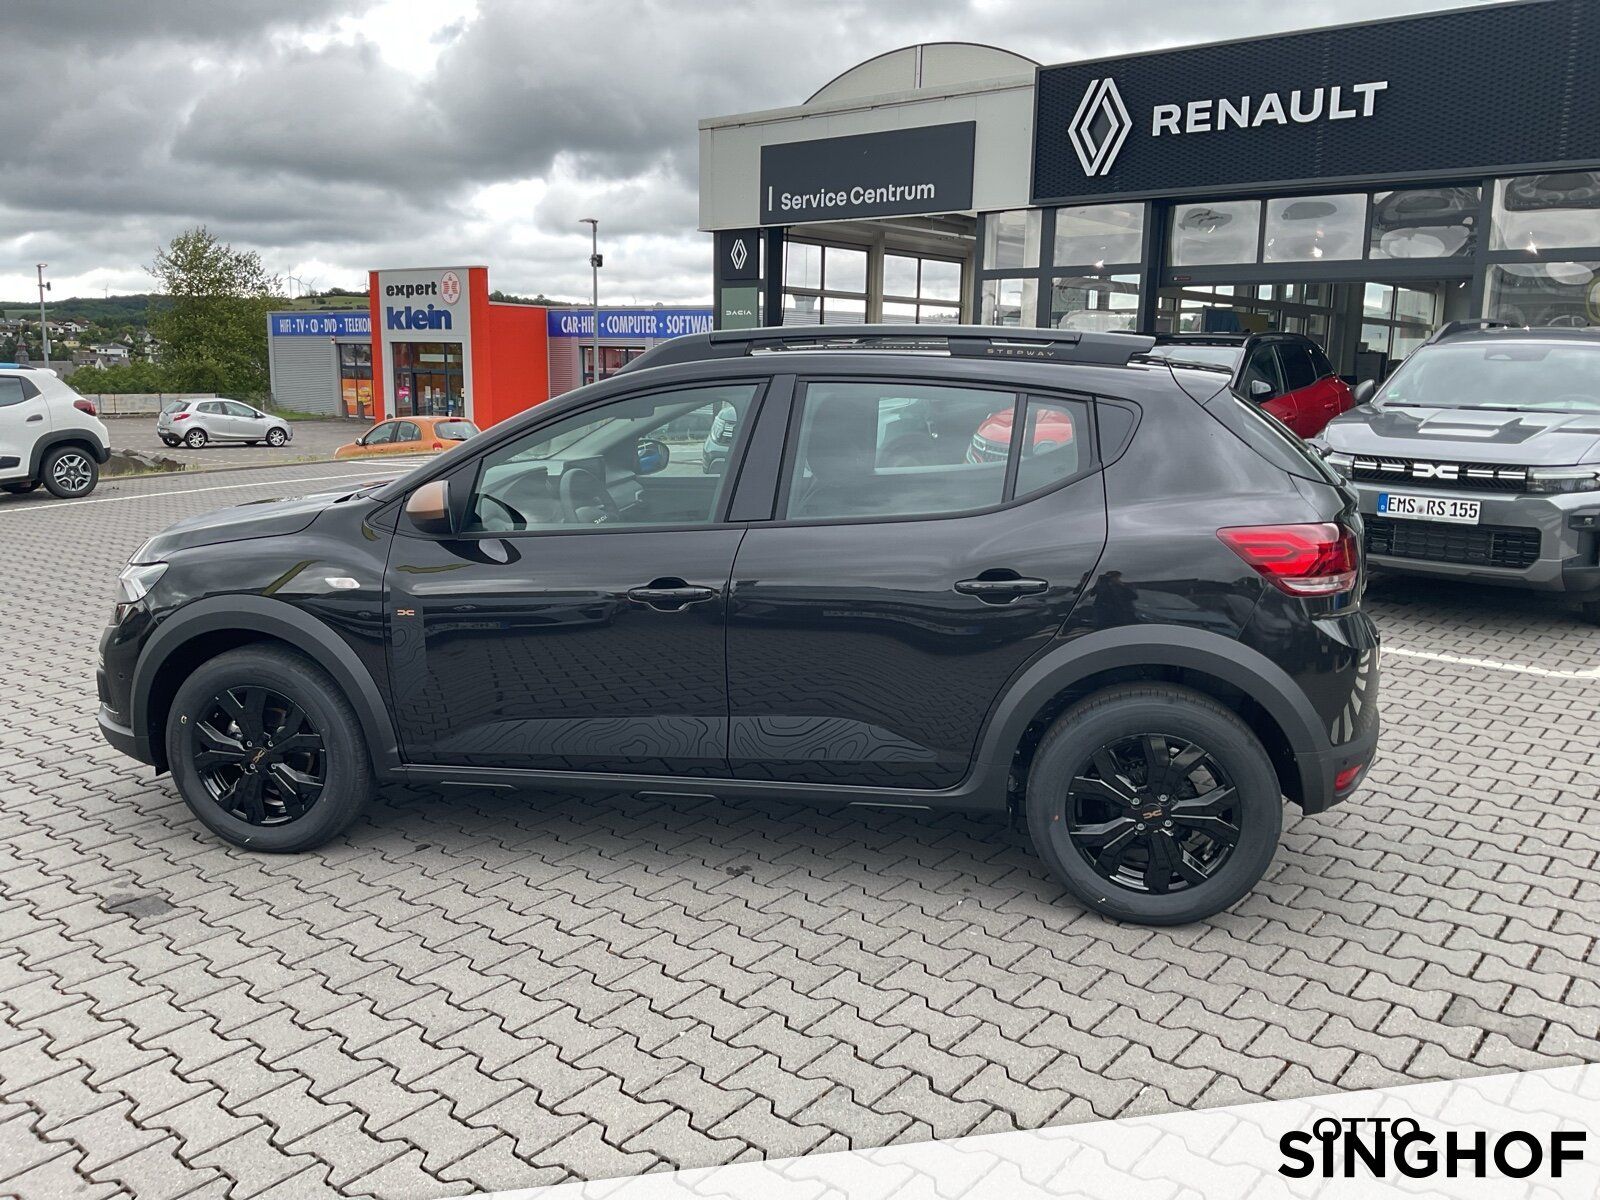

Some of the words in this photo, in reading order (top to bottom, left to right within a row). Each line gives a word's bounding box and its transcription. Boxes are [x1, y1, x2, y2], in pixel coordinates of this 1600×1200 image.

[1151, 80, 1388, 137] RENAULT
[780, 188, 847, 211] Service
[850, 183, 935, 205] Centrum
[386, 281, 437, 298] expert
[279, 318, 292, 333] HIFI
[296, 318, 305, 333] TV
[310, 318, 319, 333] CD
[324, 318, 337, 333] DVD
[386, 303, 452, 330] klein
[606, 315, 658, 334] COMPUTER
[666, 315, 714, 335] SOFTWAR
[986, 348, 1055, 357] STEPWAY
[1387, 497, 1416, 514] EMS
[1426, 500, 1447, 516] RS
[1449, 502, 1479, 519] 155
